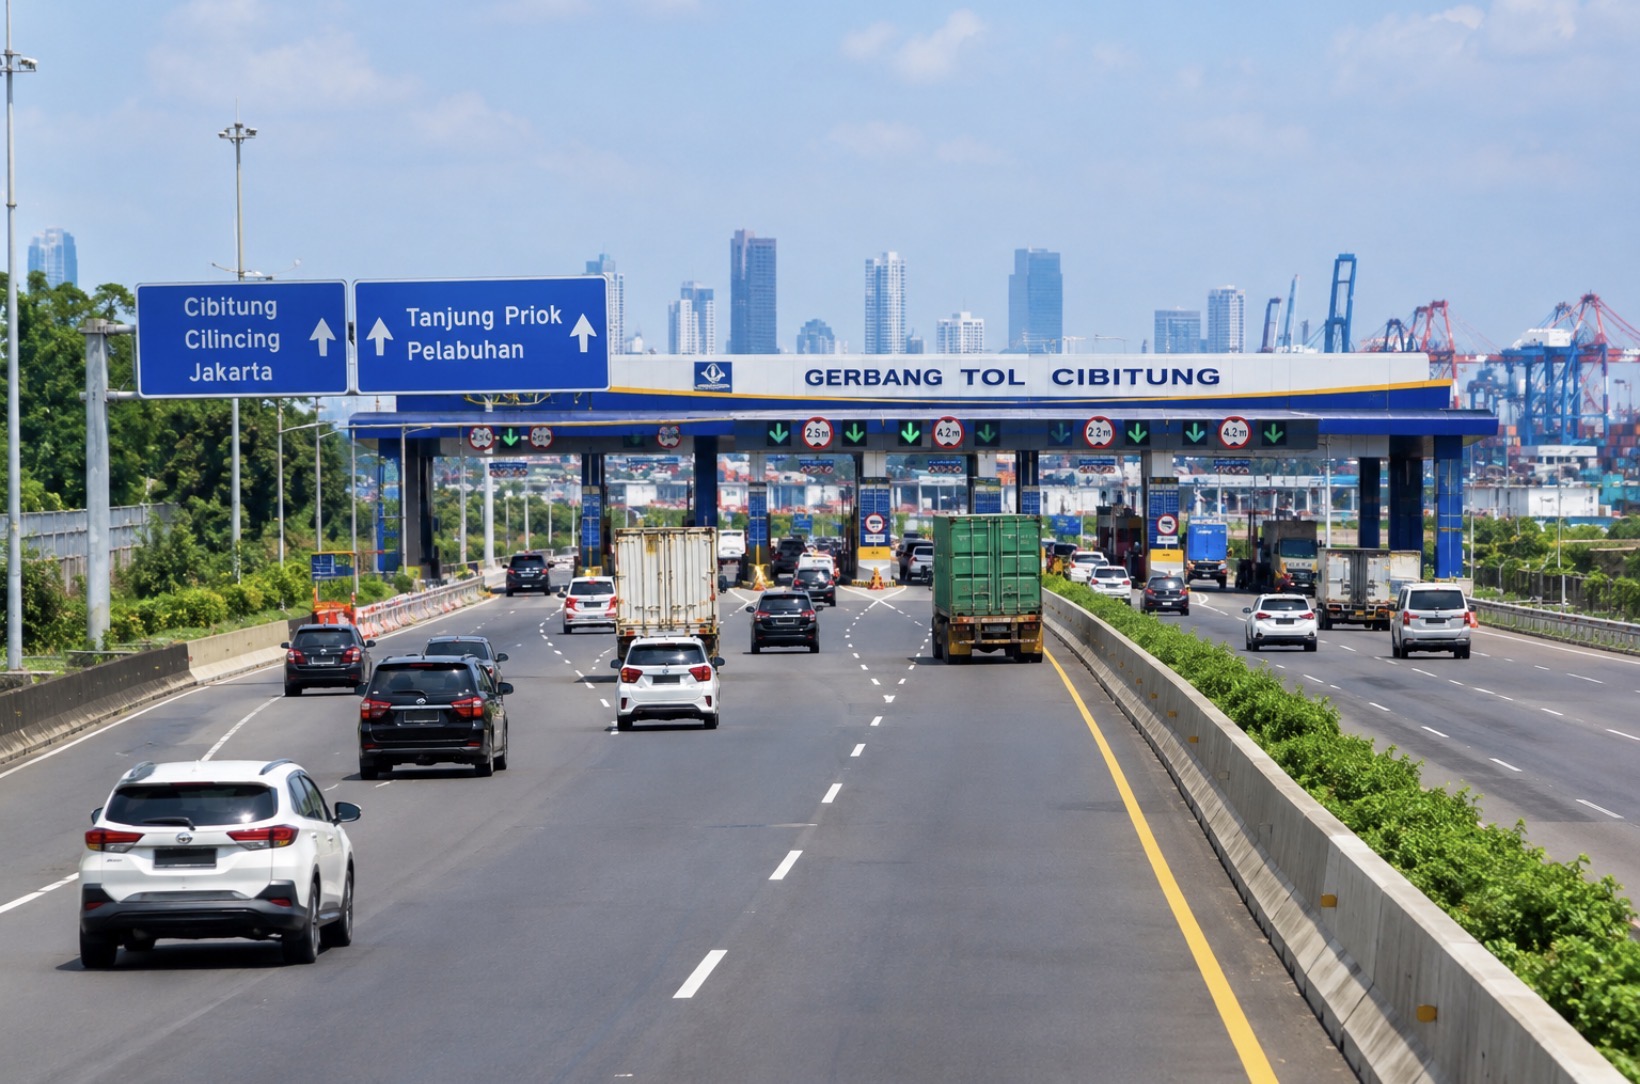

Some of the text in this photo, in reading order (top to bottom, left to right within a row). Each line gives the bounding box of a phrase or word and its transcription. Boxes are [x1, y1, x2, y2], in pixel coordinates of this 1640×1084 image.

[184, 296, 278, 321] Cibitung
[406, 303, 563, 331] Tanjung Priok
[184, 328, 281, 353] Cilincing
[407, 339, 524, 362] Pelabuhan
[188, 361, 273, 383] Jakarta
[804, 368, 1220, 387] GERBANG TOL CIBITUNG
